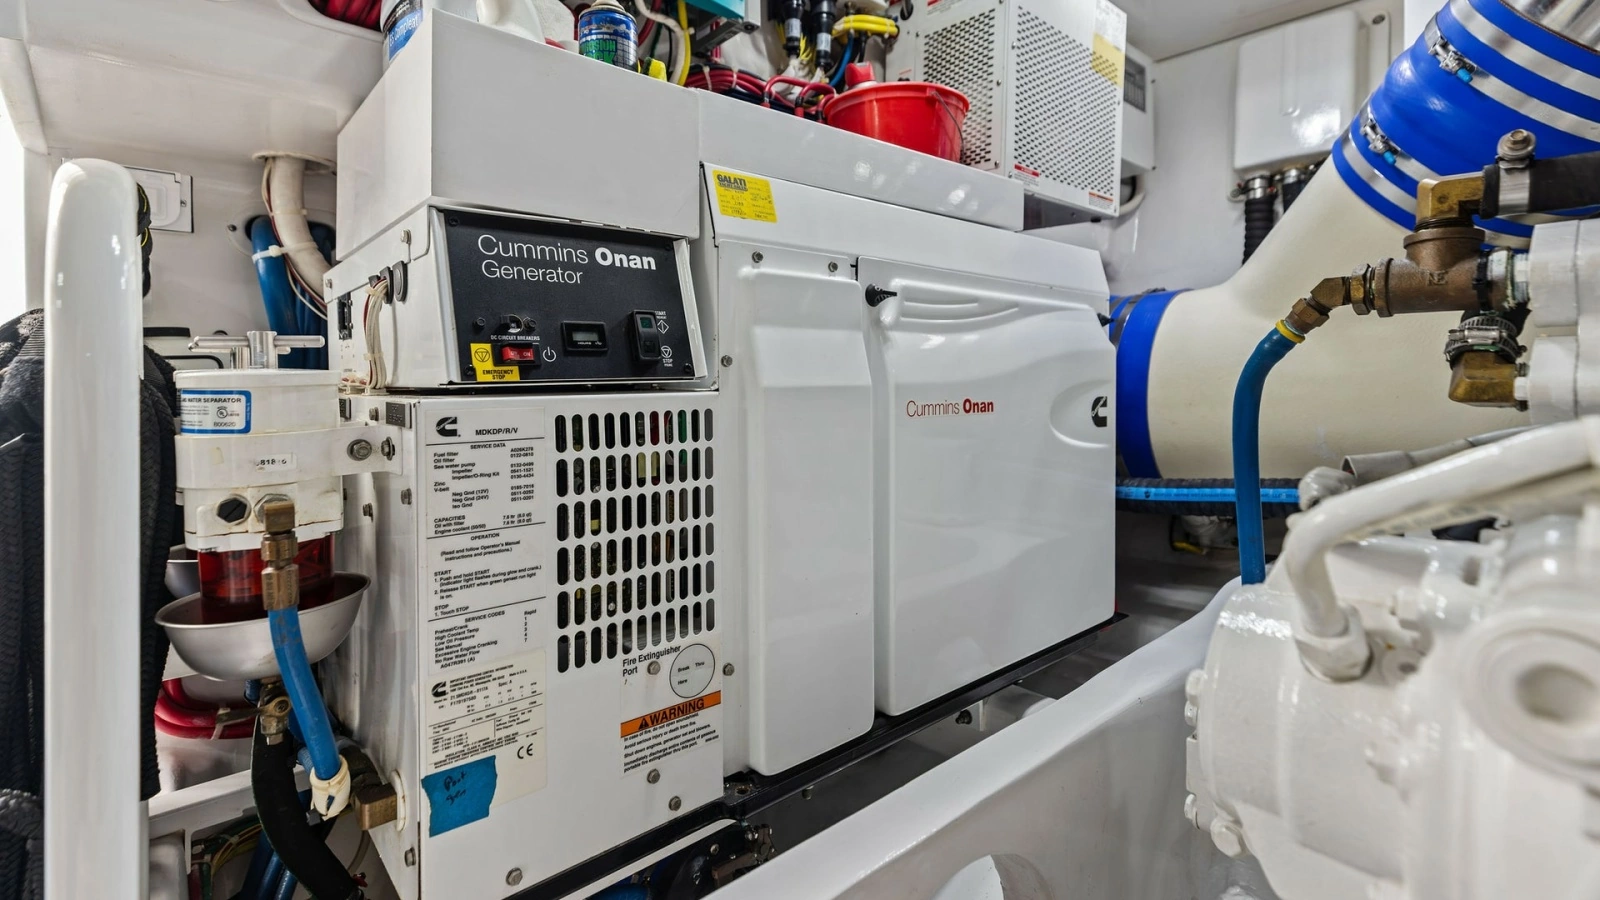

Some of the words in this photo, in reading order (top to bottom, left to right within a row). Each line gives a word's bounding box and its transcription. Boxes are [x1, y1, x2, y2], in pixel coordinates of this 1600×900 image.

[478, 234, 588, 264] Cummins
[595, 247, 656, 270] Onan
[482, 259, 583, 284] Generator
[906, 400, 960, 418] Cummins
[963, 398, 994, 414] Onan
[475, 428, 518, 436] MDKDP/R/V
[434, 515, 465, 523] CAPACITIES
[481, 542, 504, 550] Operator's
[445, 553, 472, 561] instructions
[484, 547, 512, 556] precautions.)
[440, 579, 462, 587] (Indicator
[465, 614, 486, 623] SERVICE
[434, 624, 468, 635] Preheat/Crank
[454, 635, 475, 643] Pressure
[435, 649, 459, 658] Excessive
[477, 640, 497, 649] Cranking
[623, 658, 636, 667] Fire
[638, 645, 681, 663] Extinguisher
[623, 666, 638, 677] Port
[650, 698, 704, 725] WARNING
[663, 734, 681, 744] generator
[696, 724, 710, 732] blowers.
[624, 742, 636, 750] Avoid
[637, 737, 651, 745] serious
[624, 755, 648, 767] Immediately
[649, 747, 668, 757] discharge
[680, 736, 695, 745] contents
[624, 763, 641, 774] portable
[649, 751, 672, 762] extinguisher
